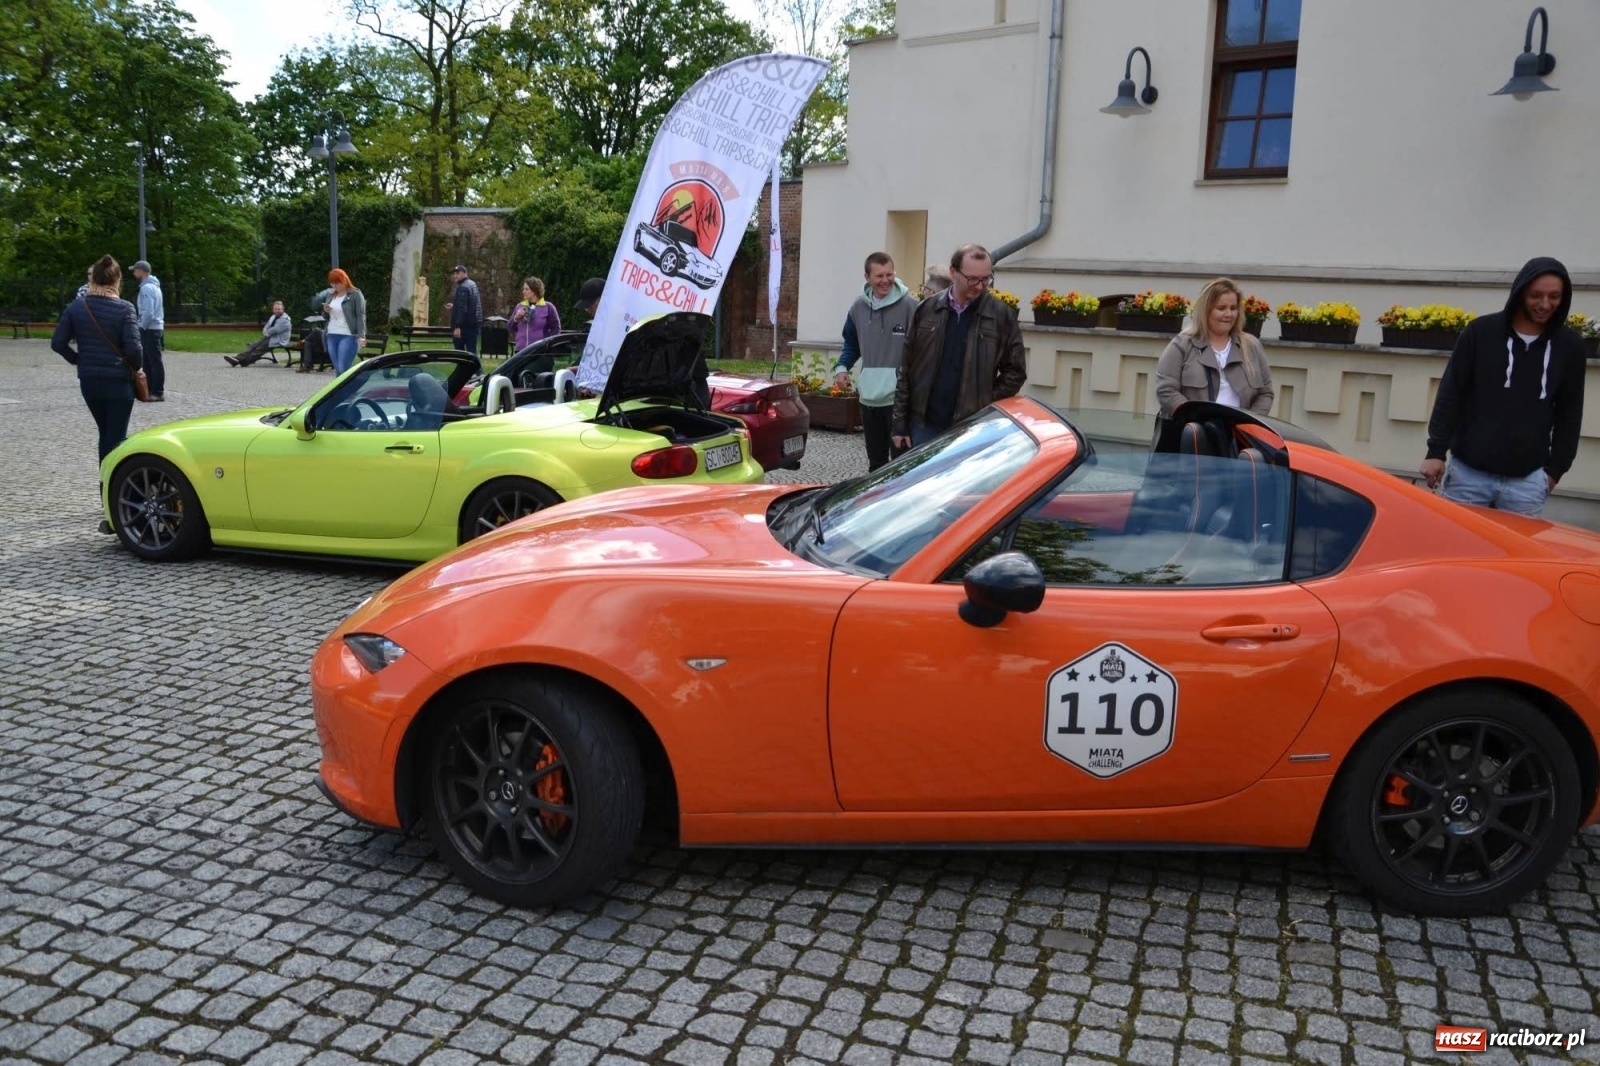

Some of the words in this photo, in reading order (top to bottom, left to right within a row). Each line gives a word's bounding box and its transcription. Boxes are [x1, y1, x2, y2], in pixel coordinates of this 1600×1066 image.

[1057, 692, 1165, 737] 110
[1088, 748, 1124, 760] MIATA
[1088, 758, 1123, 769] CHALLENGE
